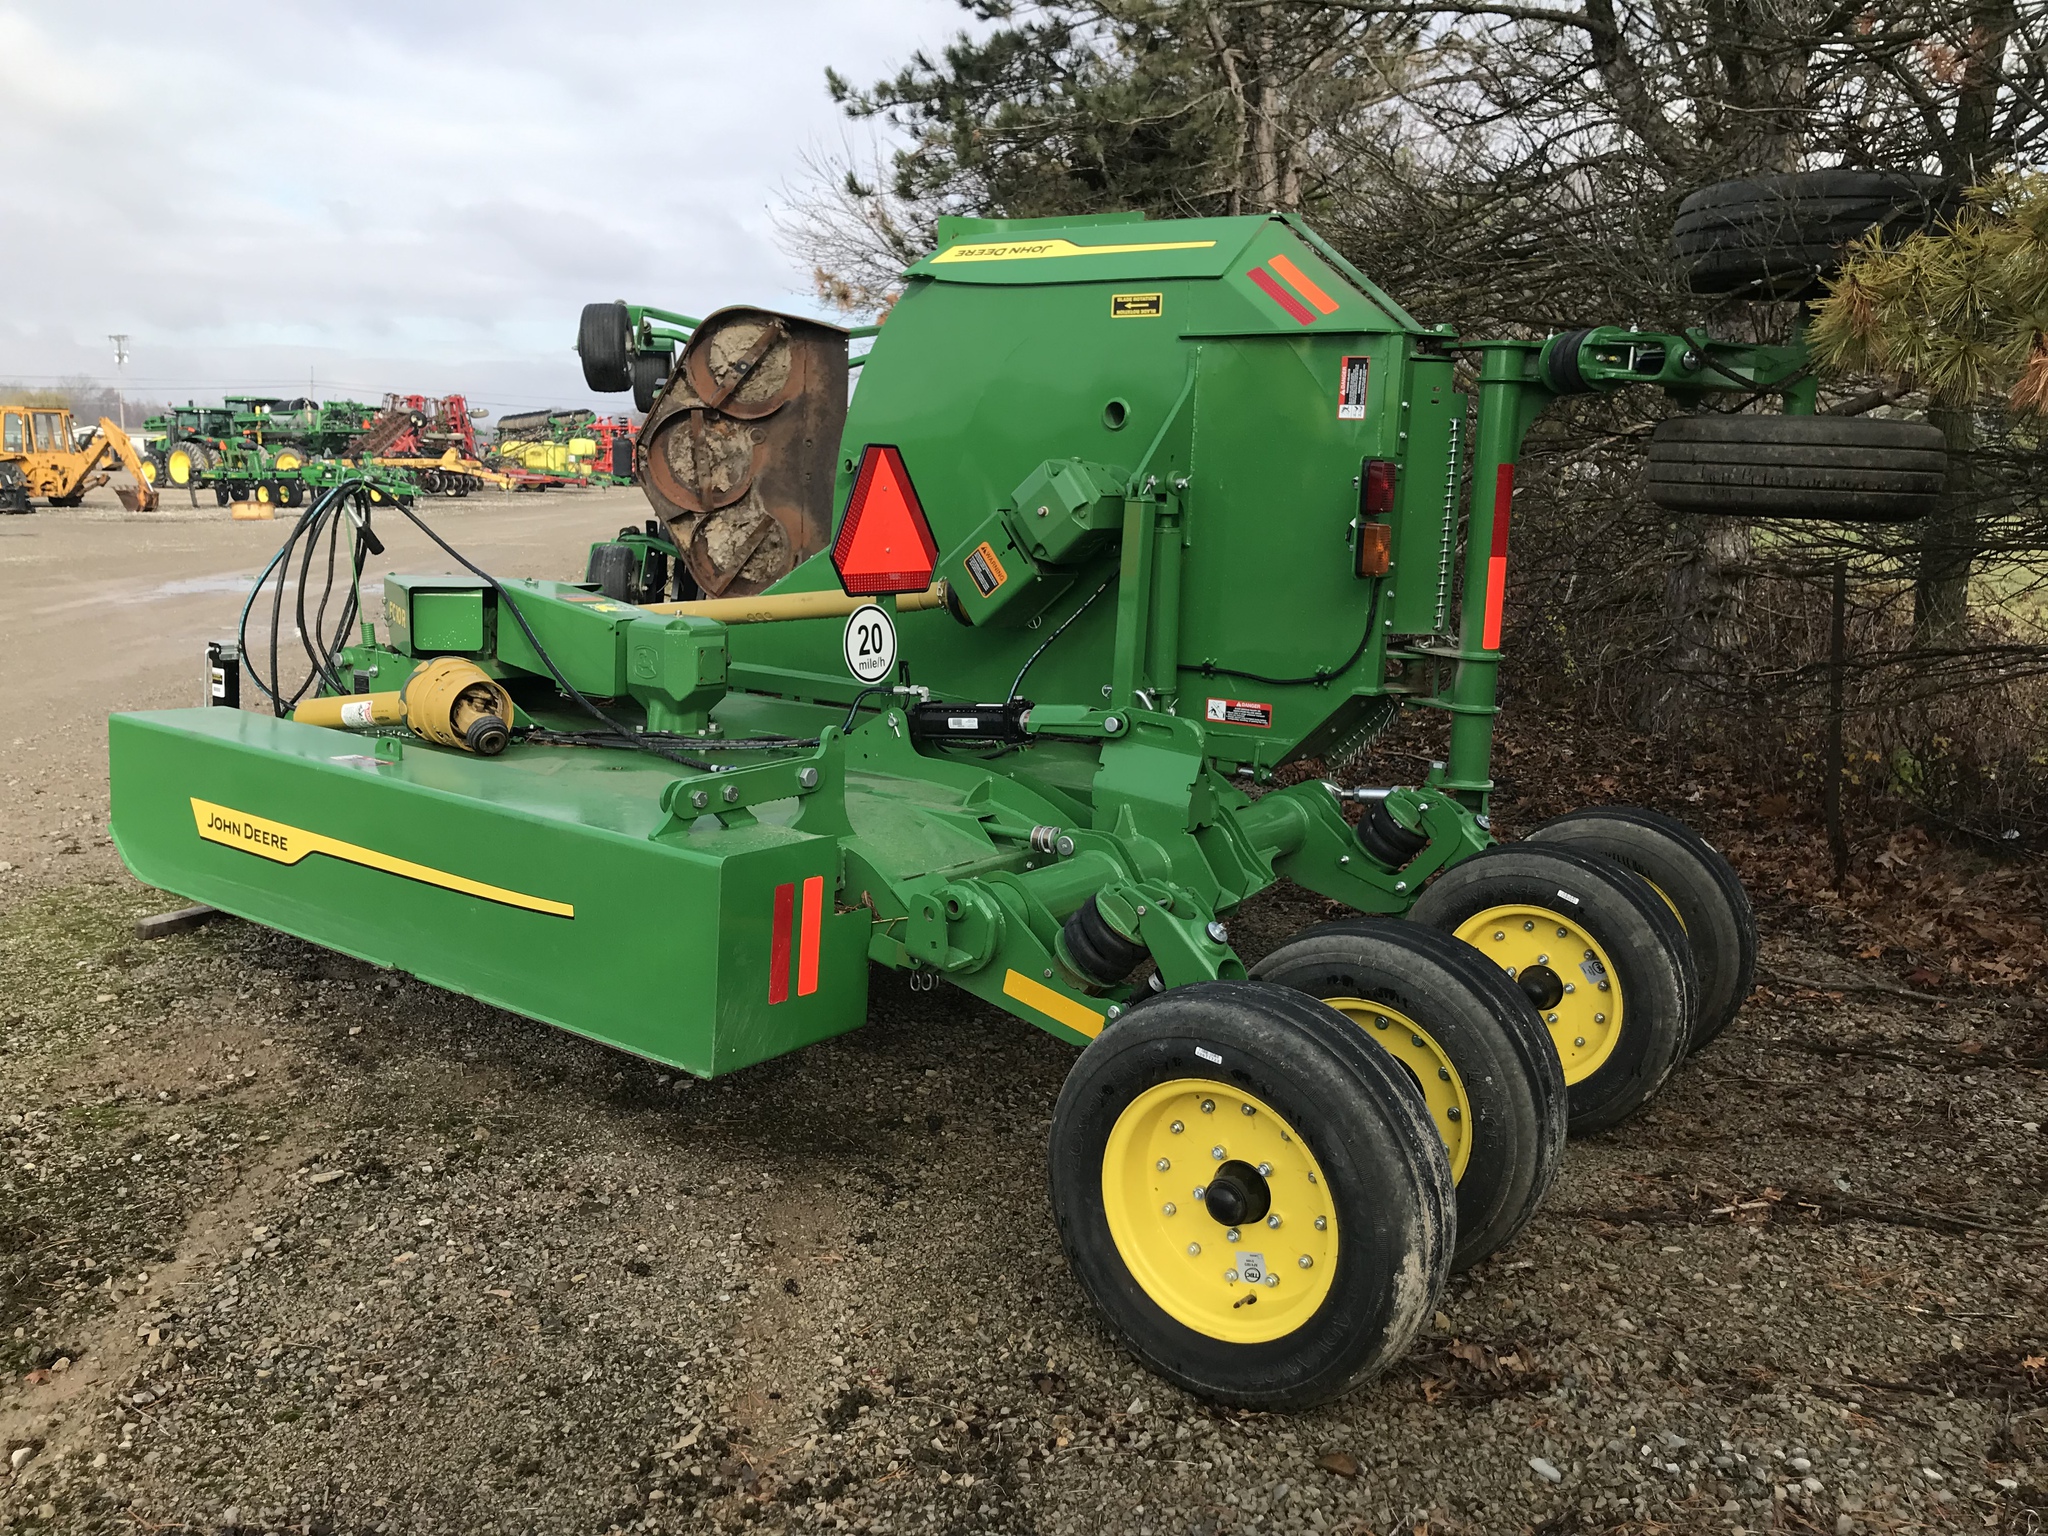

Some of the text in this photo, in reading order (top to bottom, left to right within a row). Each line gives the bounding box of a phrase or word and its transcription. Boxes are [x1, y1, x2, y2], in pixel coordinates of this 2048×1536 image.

[954, 244, 1053, 257] JOHN DEERE
[986, 553, 1005, 581] WARNING
[857, 623, 883, 656] 20
[858, 656, 886, 671] mile/h
[207, 812, 289, 851] JOHN DEERE
